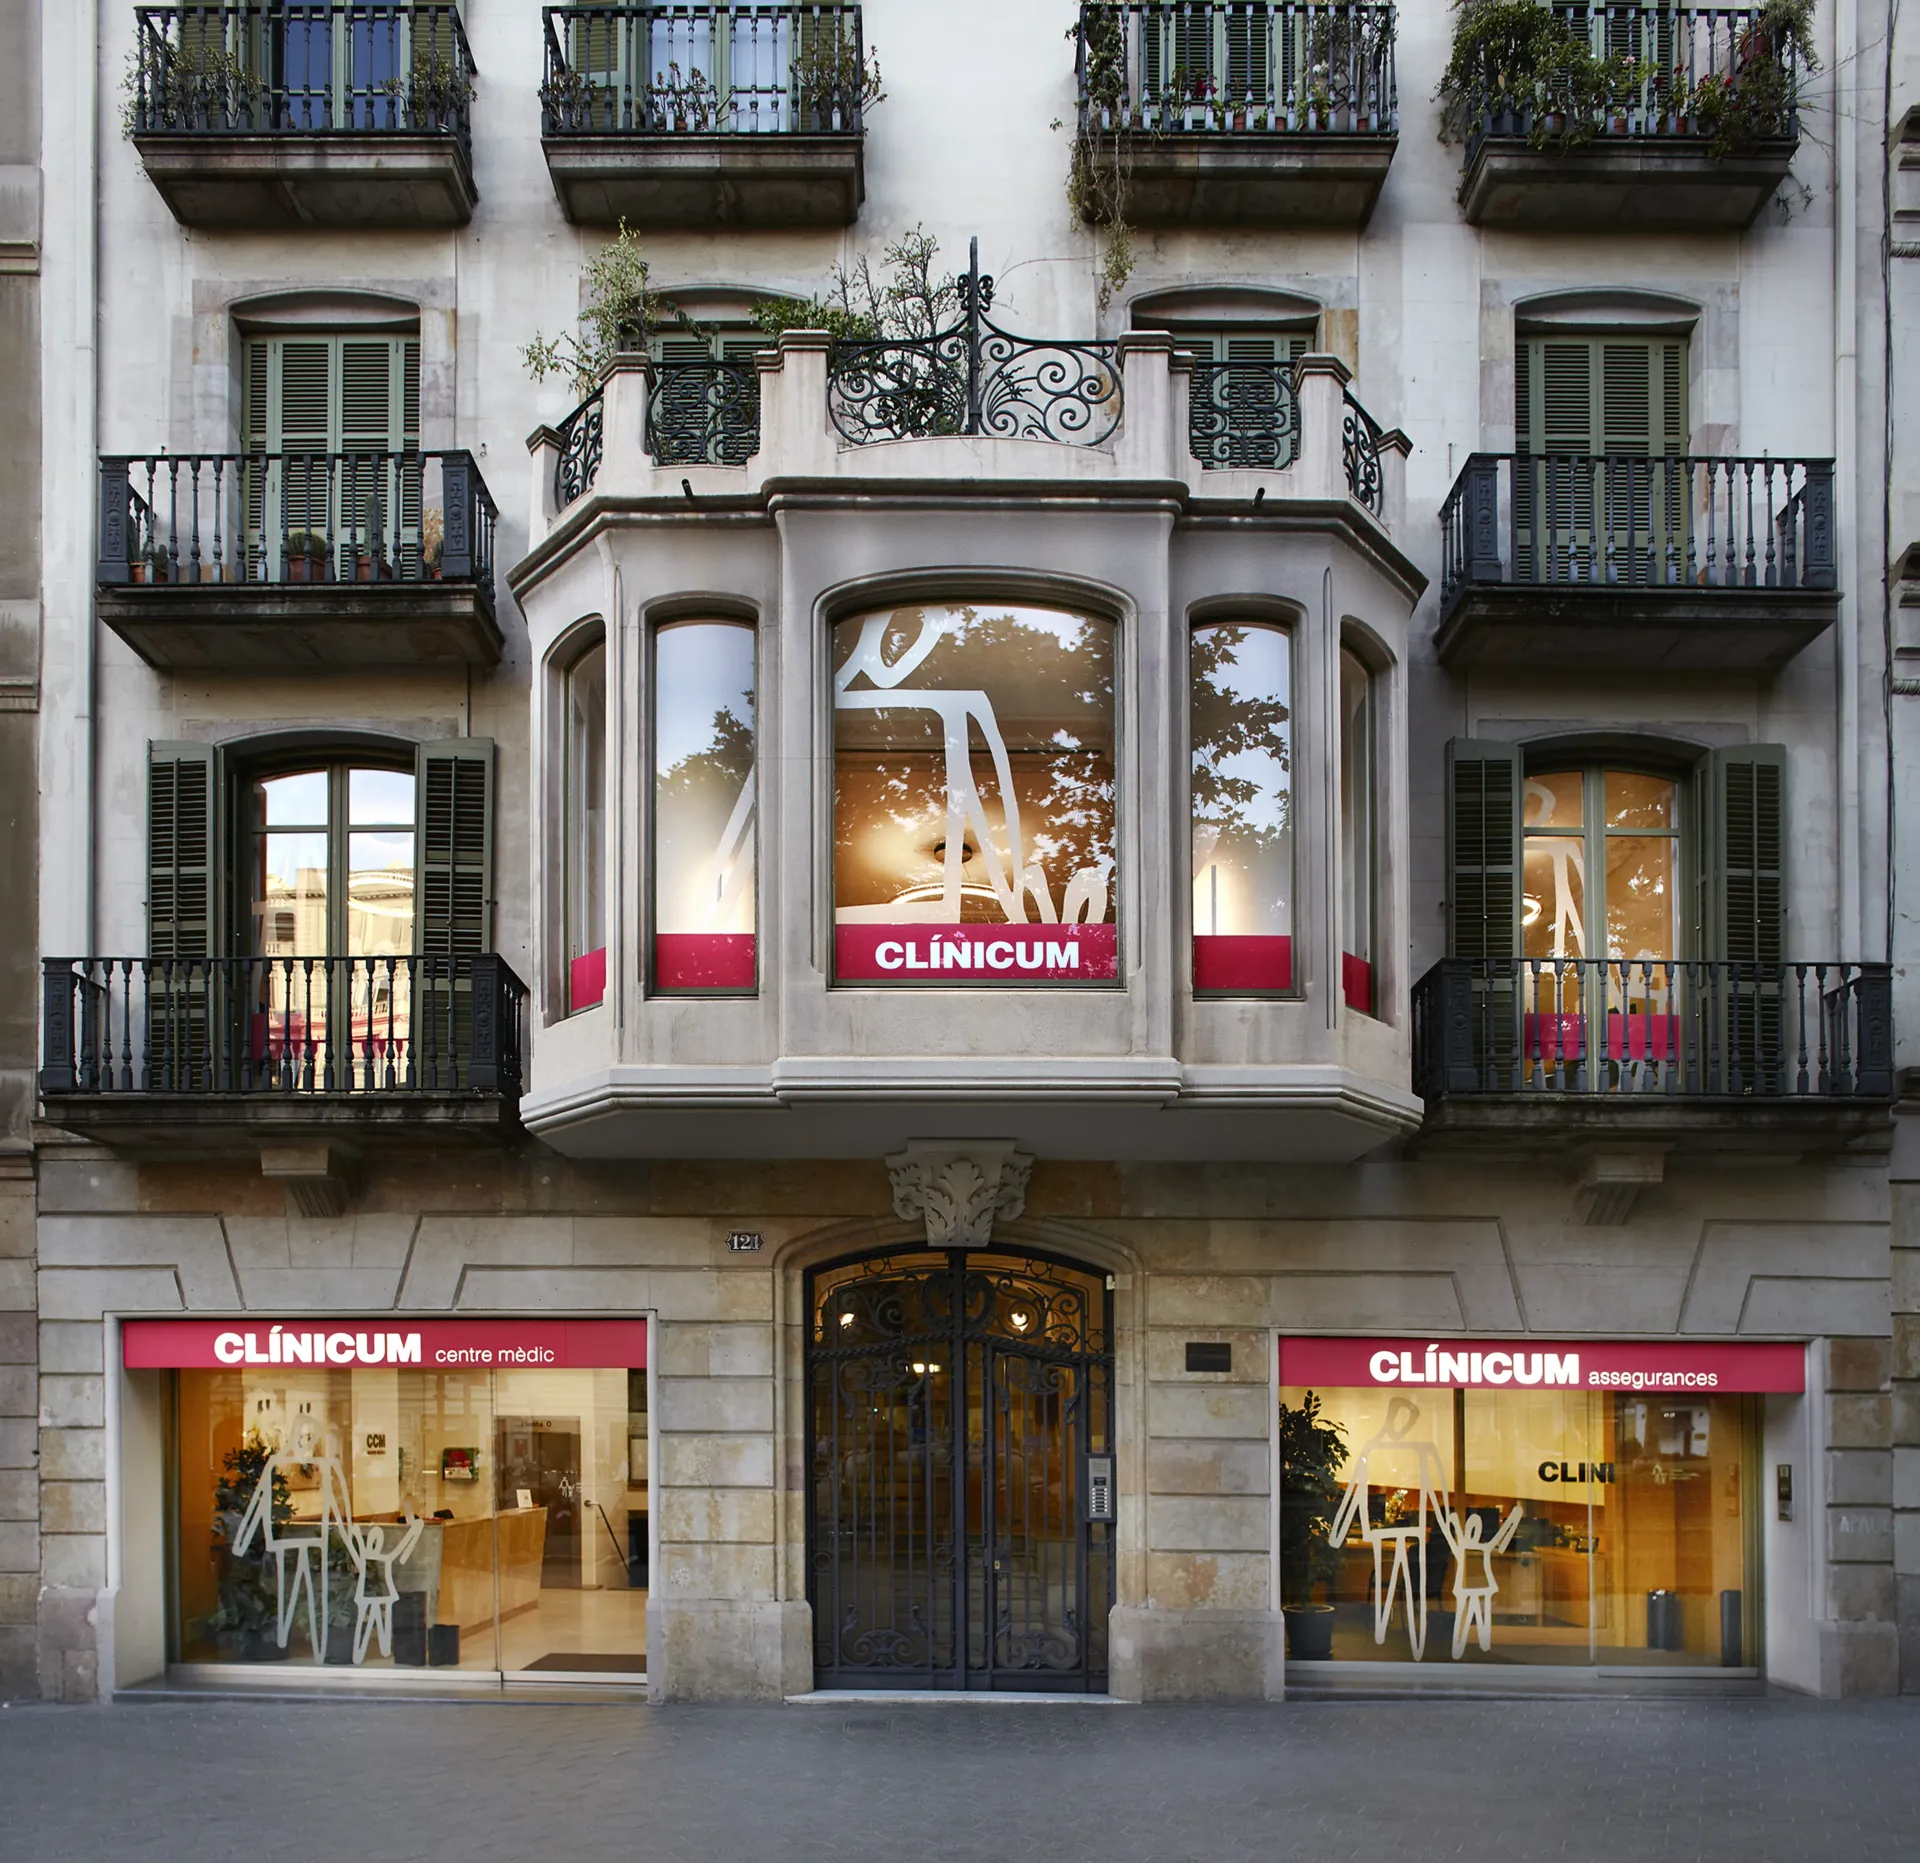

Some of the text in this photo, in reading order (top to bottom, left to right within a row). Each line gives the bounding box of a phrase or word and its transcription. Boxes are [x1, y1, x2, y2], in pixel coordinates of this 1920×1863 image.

[875, 934, 1079, 969] CLÍNICUM
[733, 1234, 760, 1250] 121
[214, 1325, 555, 1363] CLÍNICUM centre mèdic
[1369, 1344, 1718, 1389] CLÍNICUM assegurances
